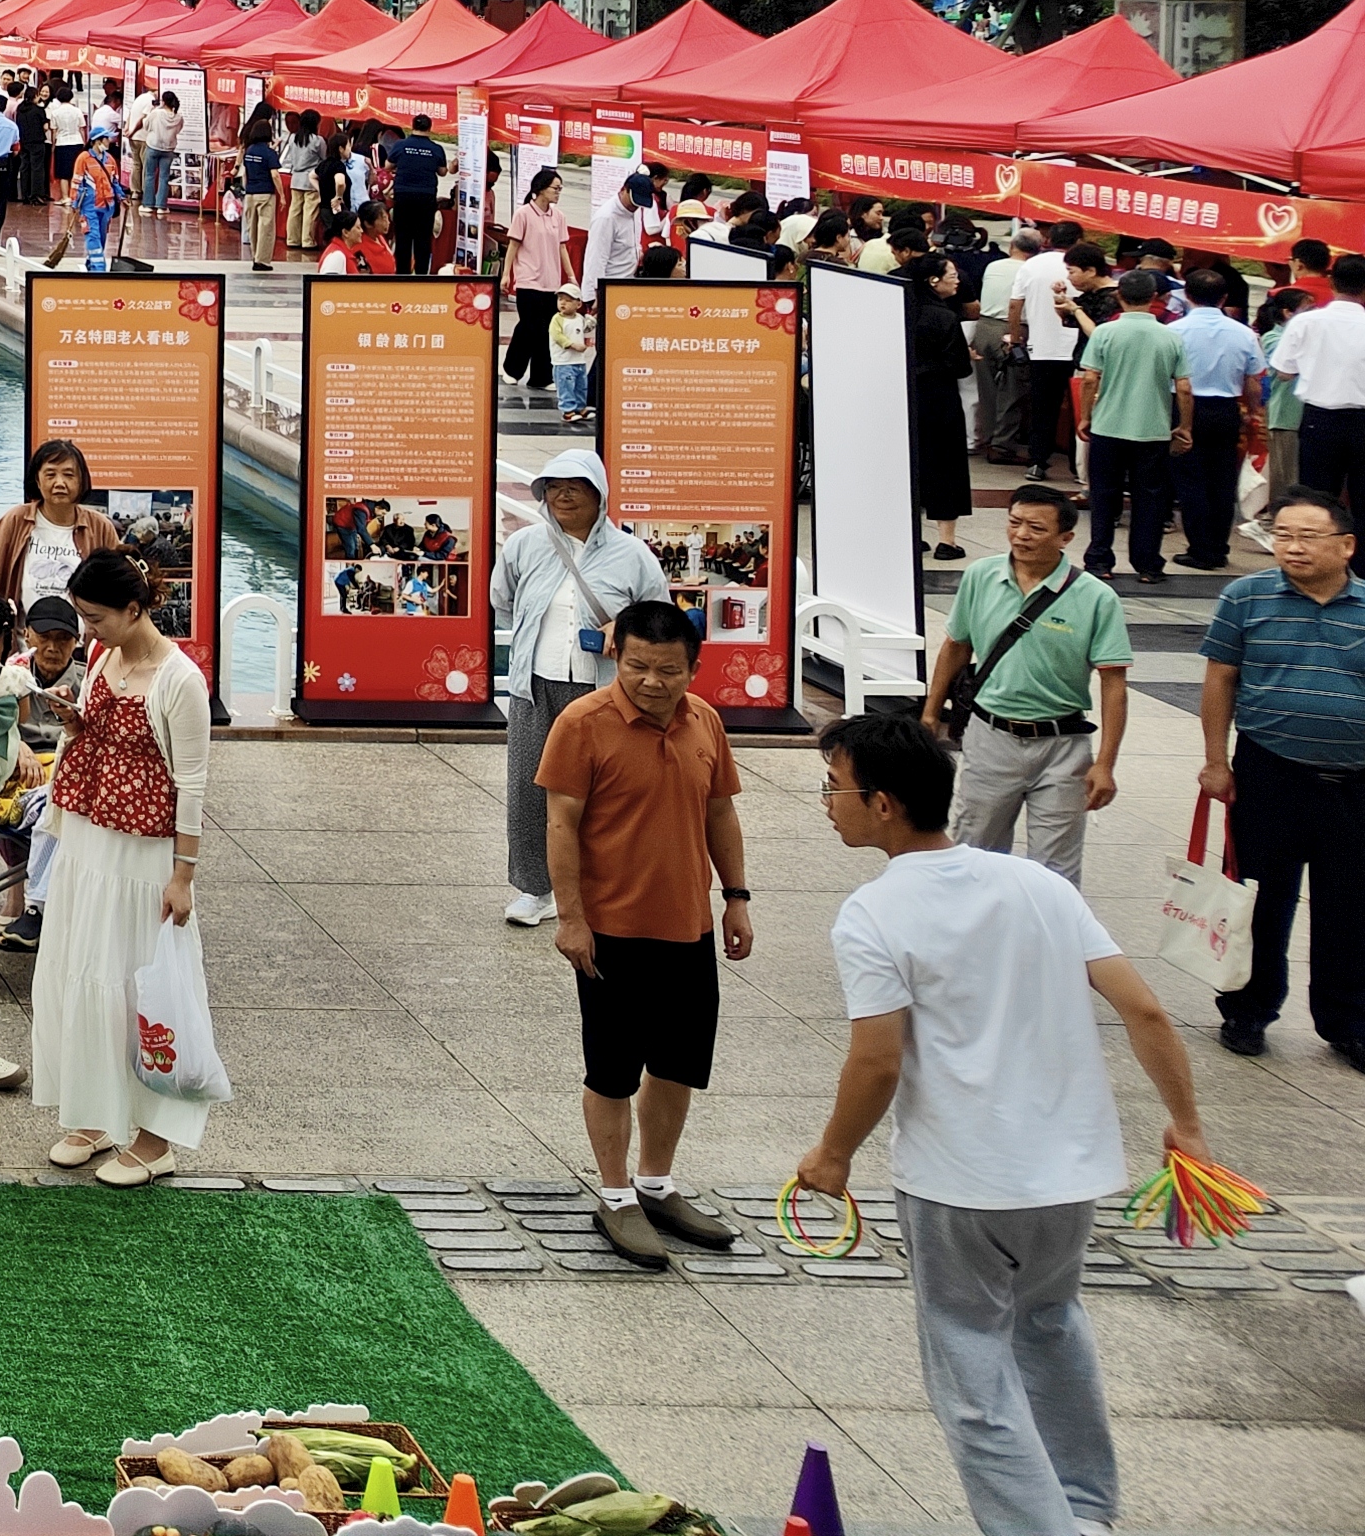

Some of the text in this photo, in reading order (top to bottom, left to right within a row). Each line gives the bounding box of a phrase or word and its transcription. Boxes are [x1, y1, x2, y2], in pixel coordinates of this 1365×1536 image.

[59, 329, 190, 346] 万名特困老人看电影
